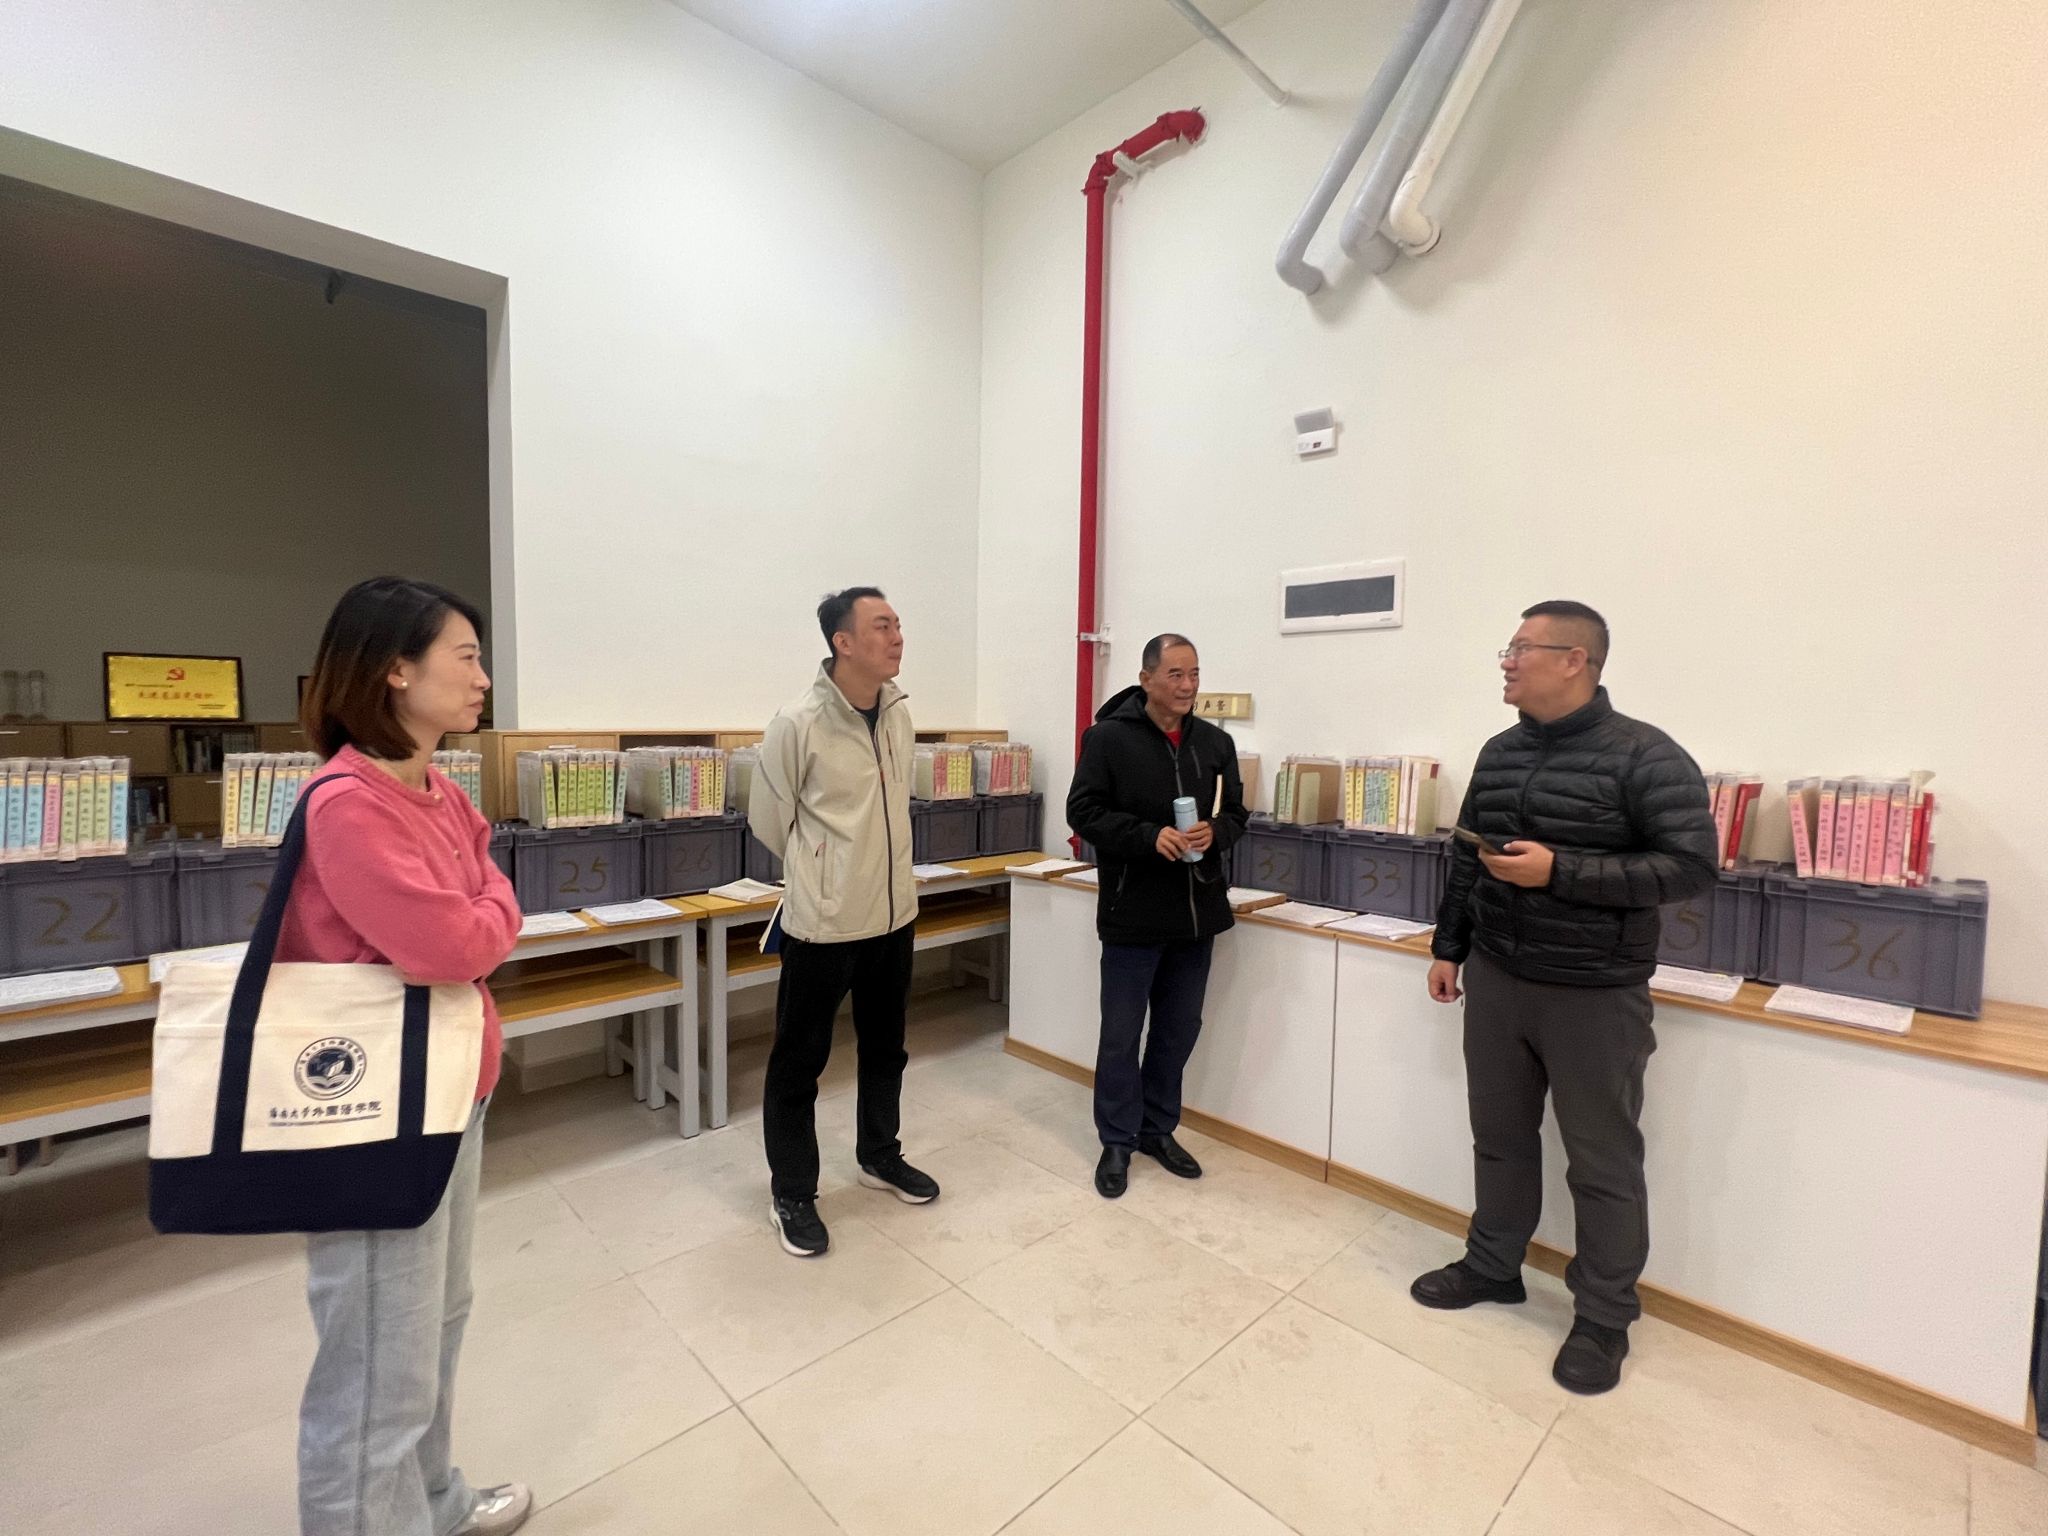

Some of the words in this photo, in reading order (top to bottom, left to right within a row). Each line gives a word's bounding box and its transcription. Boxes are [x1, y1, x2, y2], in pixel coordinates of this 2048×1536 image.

[558, 856, 608, 893] 25
[1258, 847, 1296, 885] 32
[1358, 857, 1401, 898] 33
[33, 889, 124, 946] 22
[1664, 904, 1705, 951] 5
[1826, 918, 1904, 980] 36
